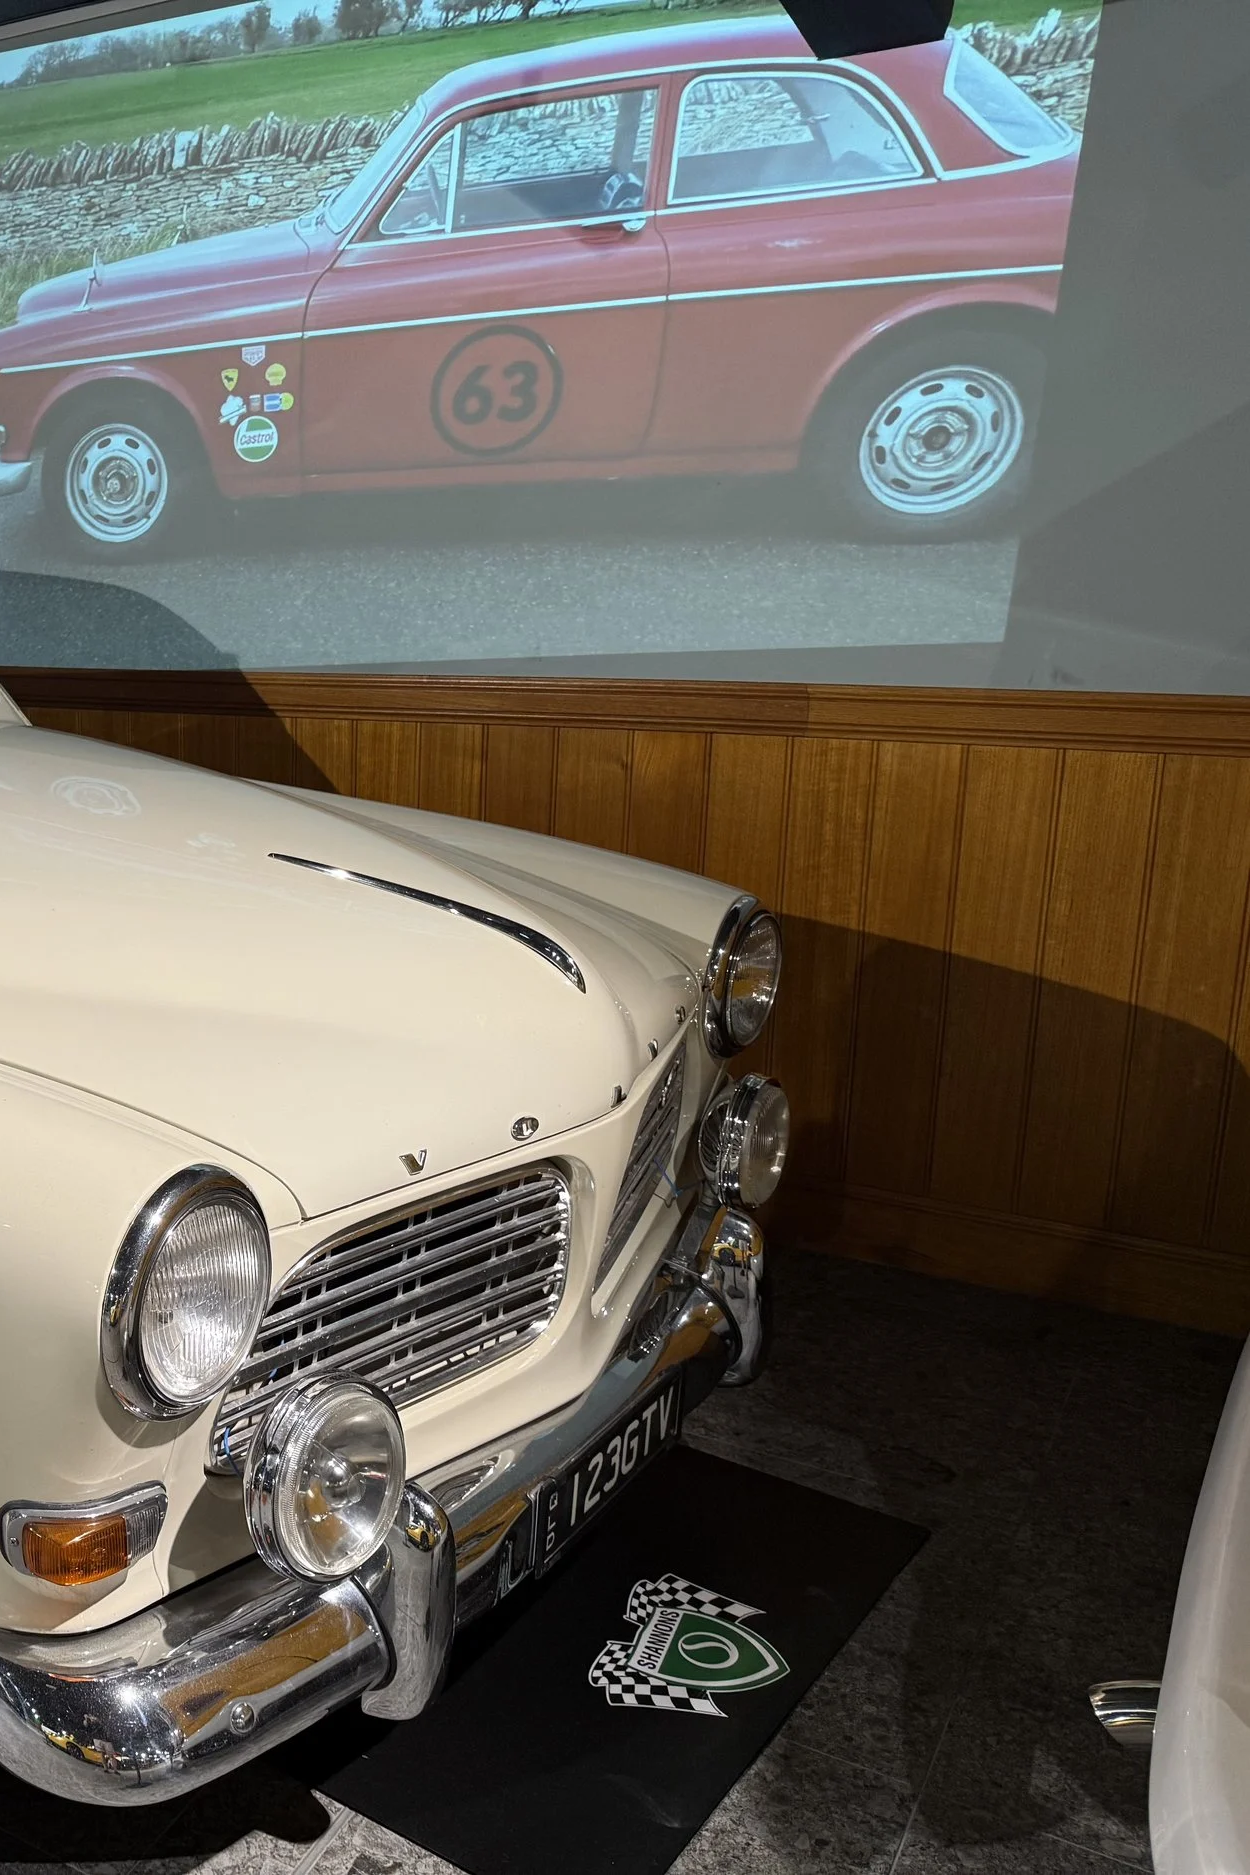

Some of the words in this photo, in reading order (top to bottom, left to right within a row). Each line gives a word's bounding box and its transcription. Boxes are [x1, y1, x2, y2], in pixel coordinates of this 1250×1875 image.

[451, 361, 539, 425] 63
[239, 431, 274, 446] Castrol
[570, 1385, 674, 1527] 123GTV
[545, 1491, 559, 1551] QLD
[637, 1609, 680, 1670] SHANNONS
